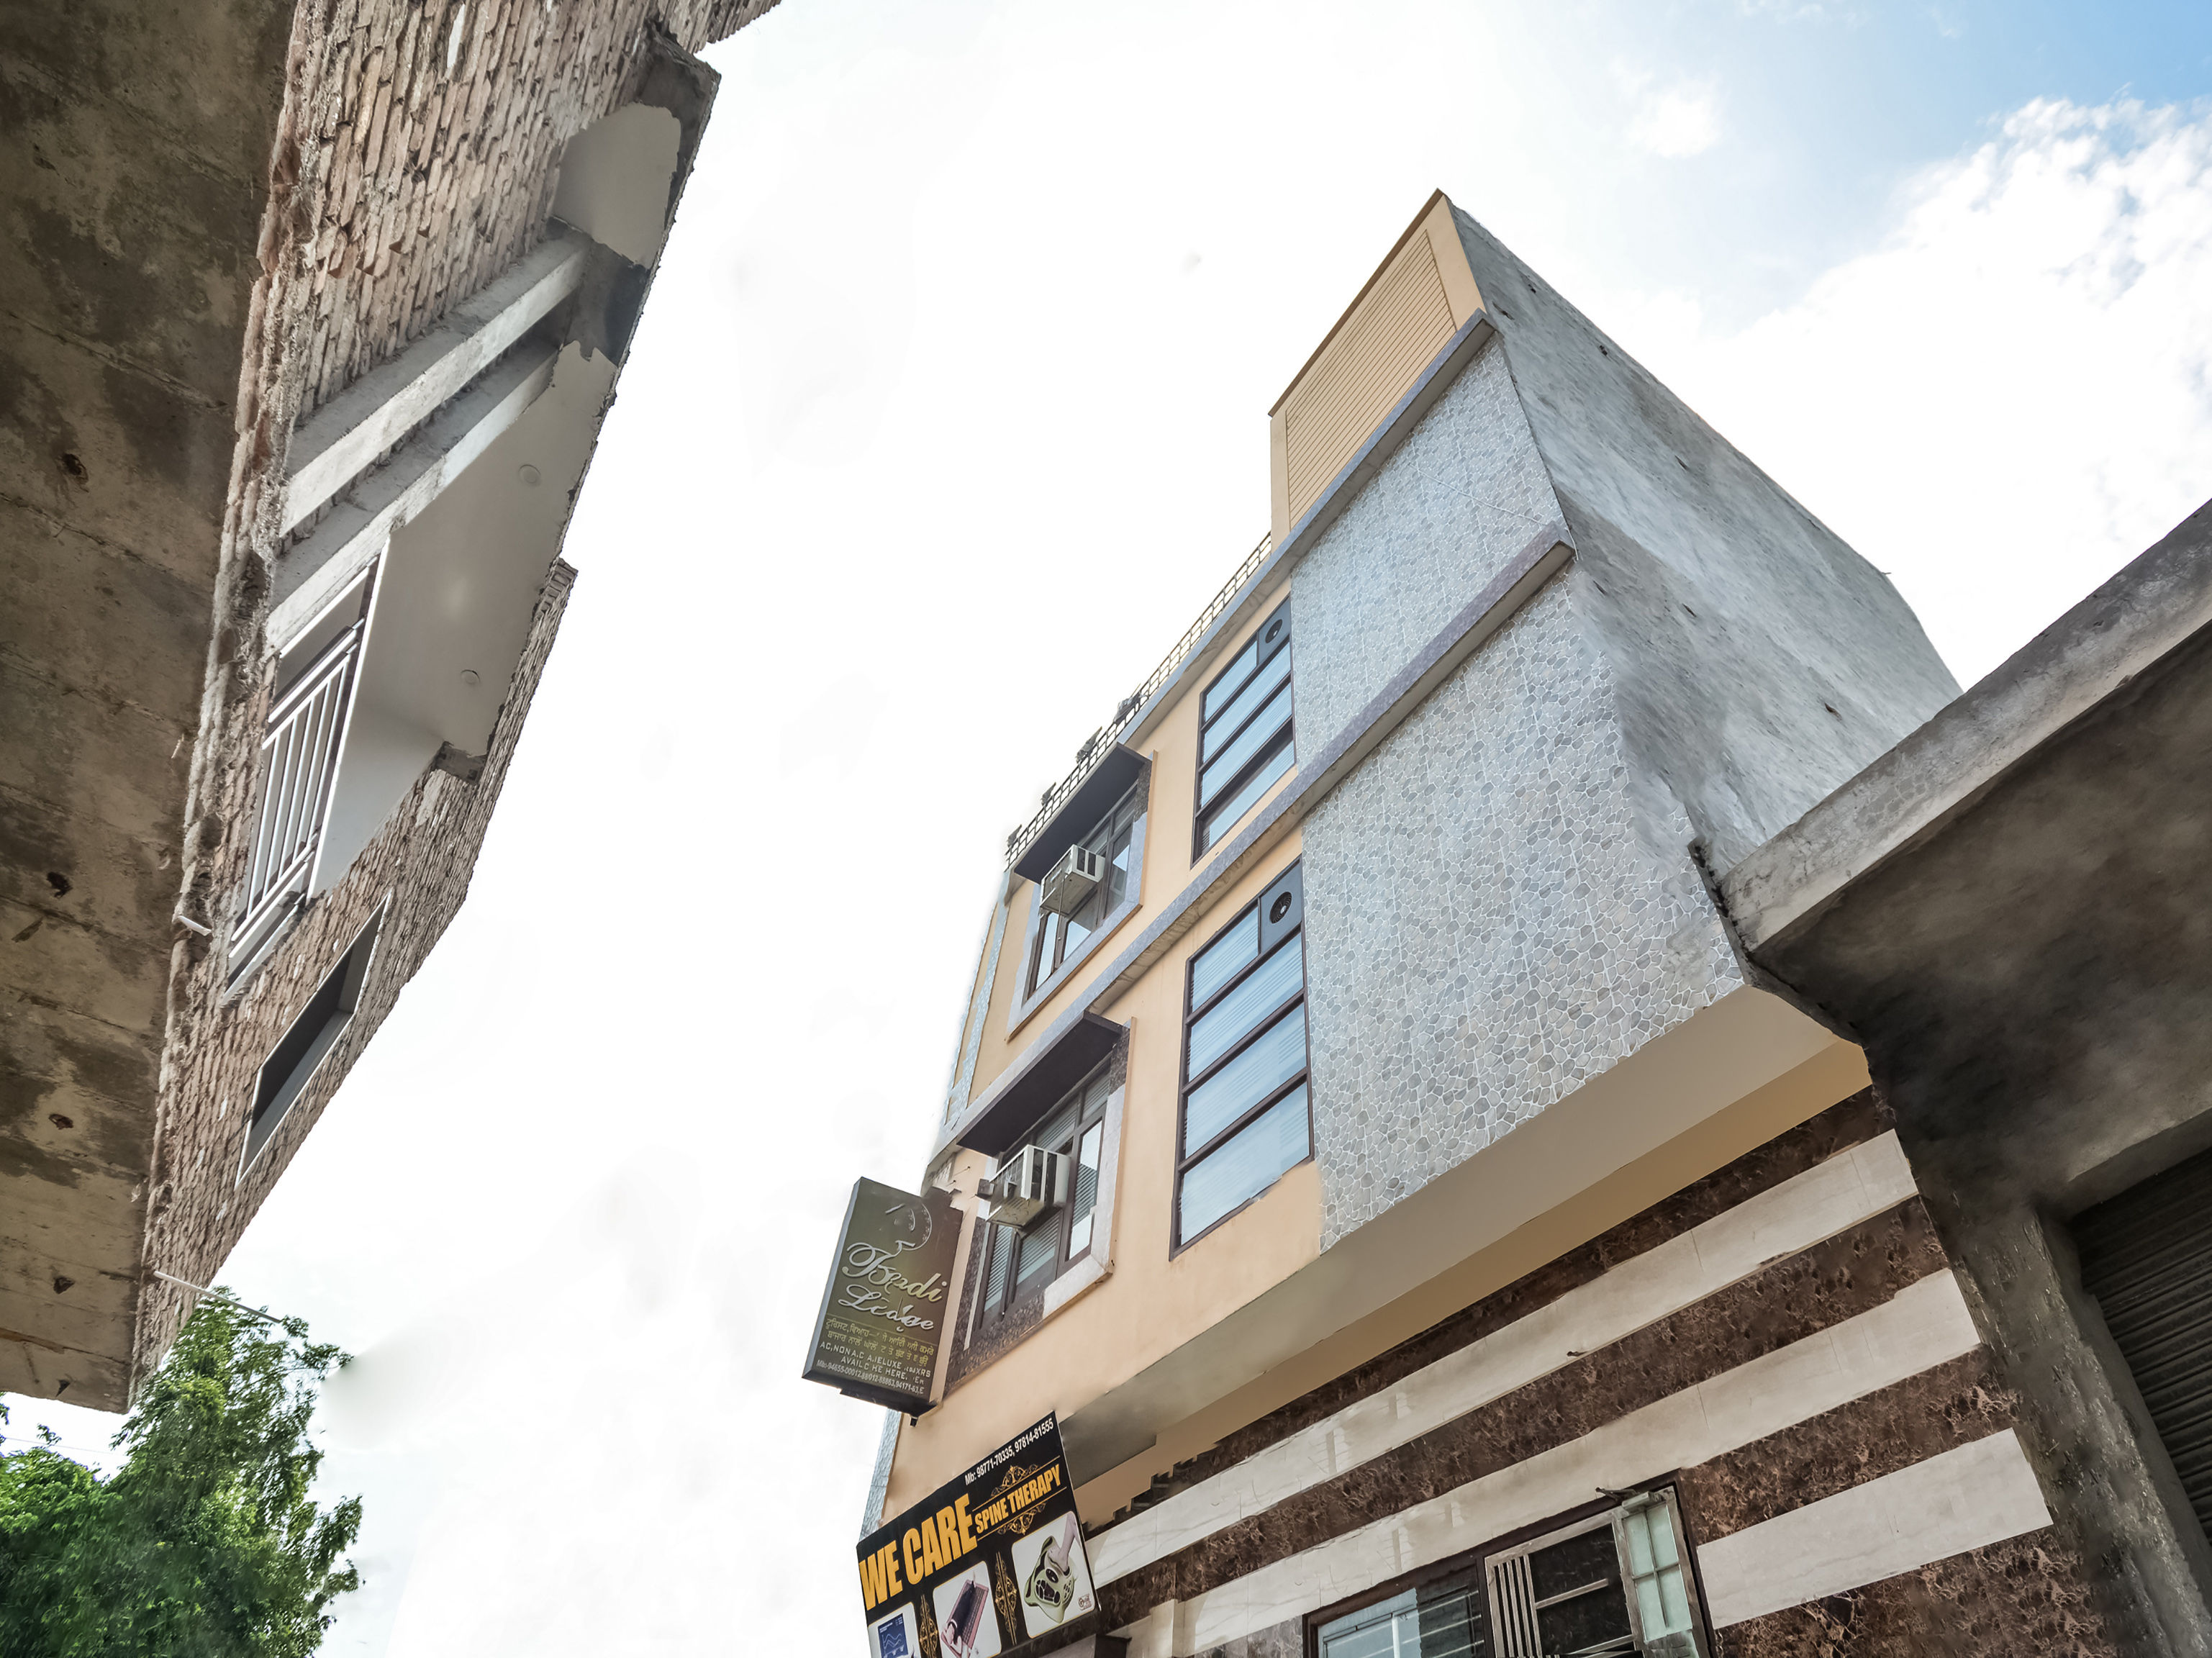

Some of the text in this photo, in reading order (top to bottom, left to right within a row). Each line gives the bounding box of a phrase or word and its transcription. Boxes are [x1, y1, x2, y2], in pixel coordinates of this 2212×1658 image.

[964, 1418, 1054, 1486] Mb: 98771-70335, 97814-81555
[974, 1464, 1061, 1534] SPINE THERAPY
[858, 1492, 978, 1611] WE CARE
